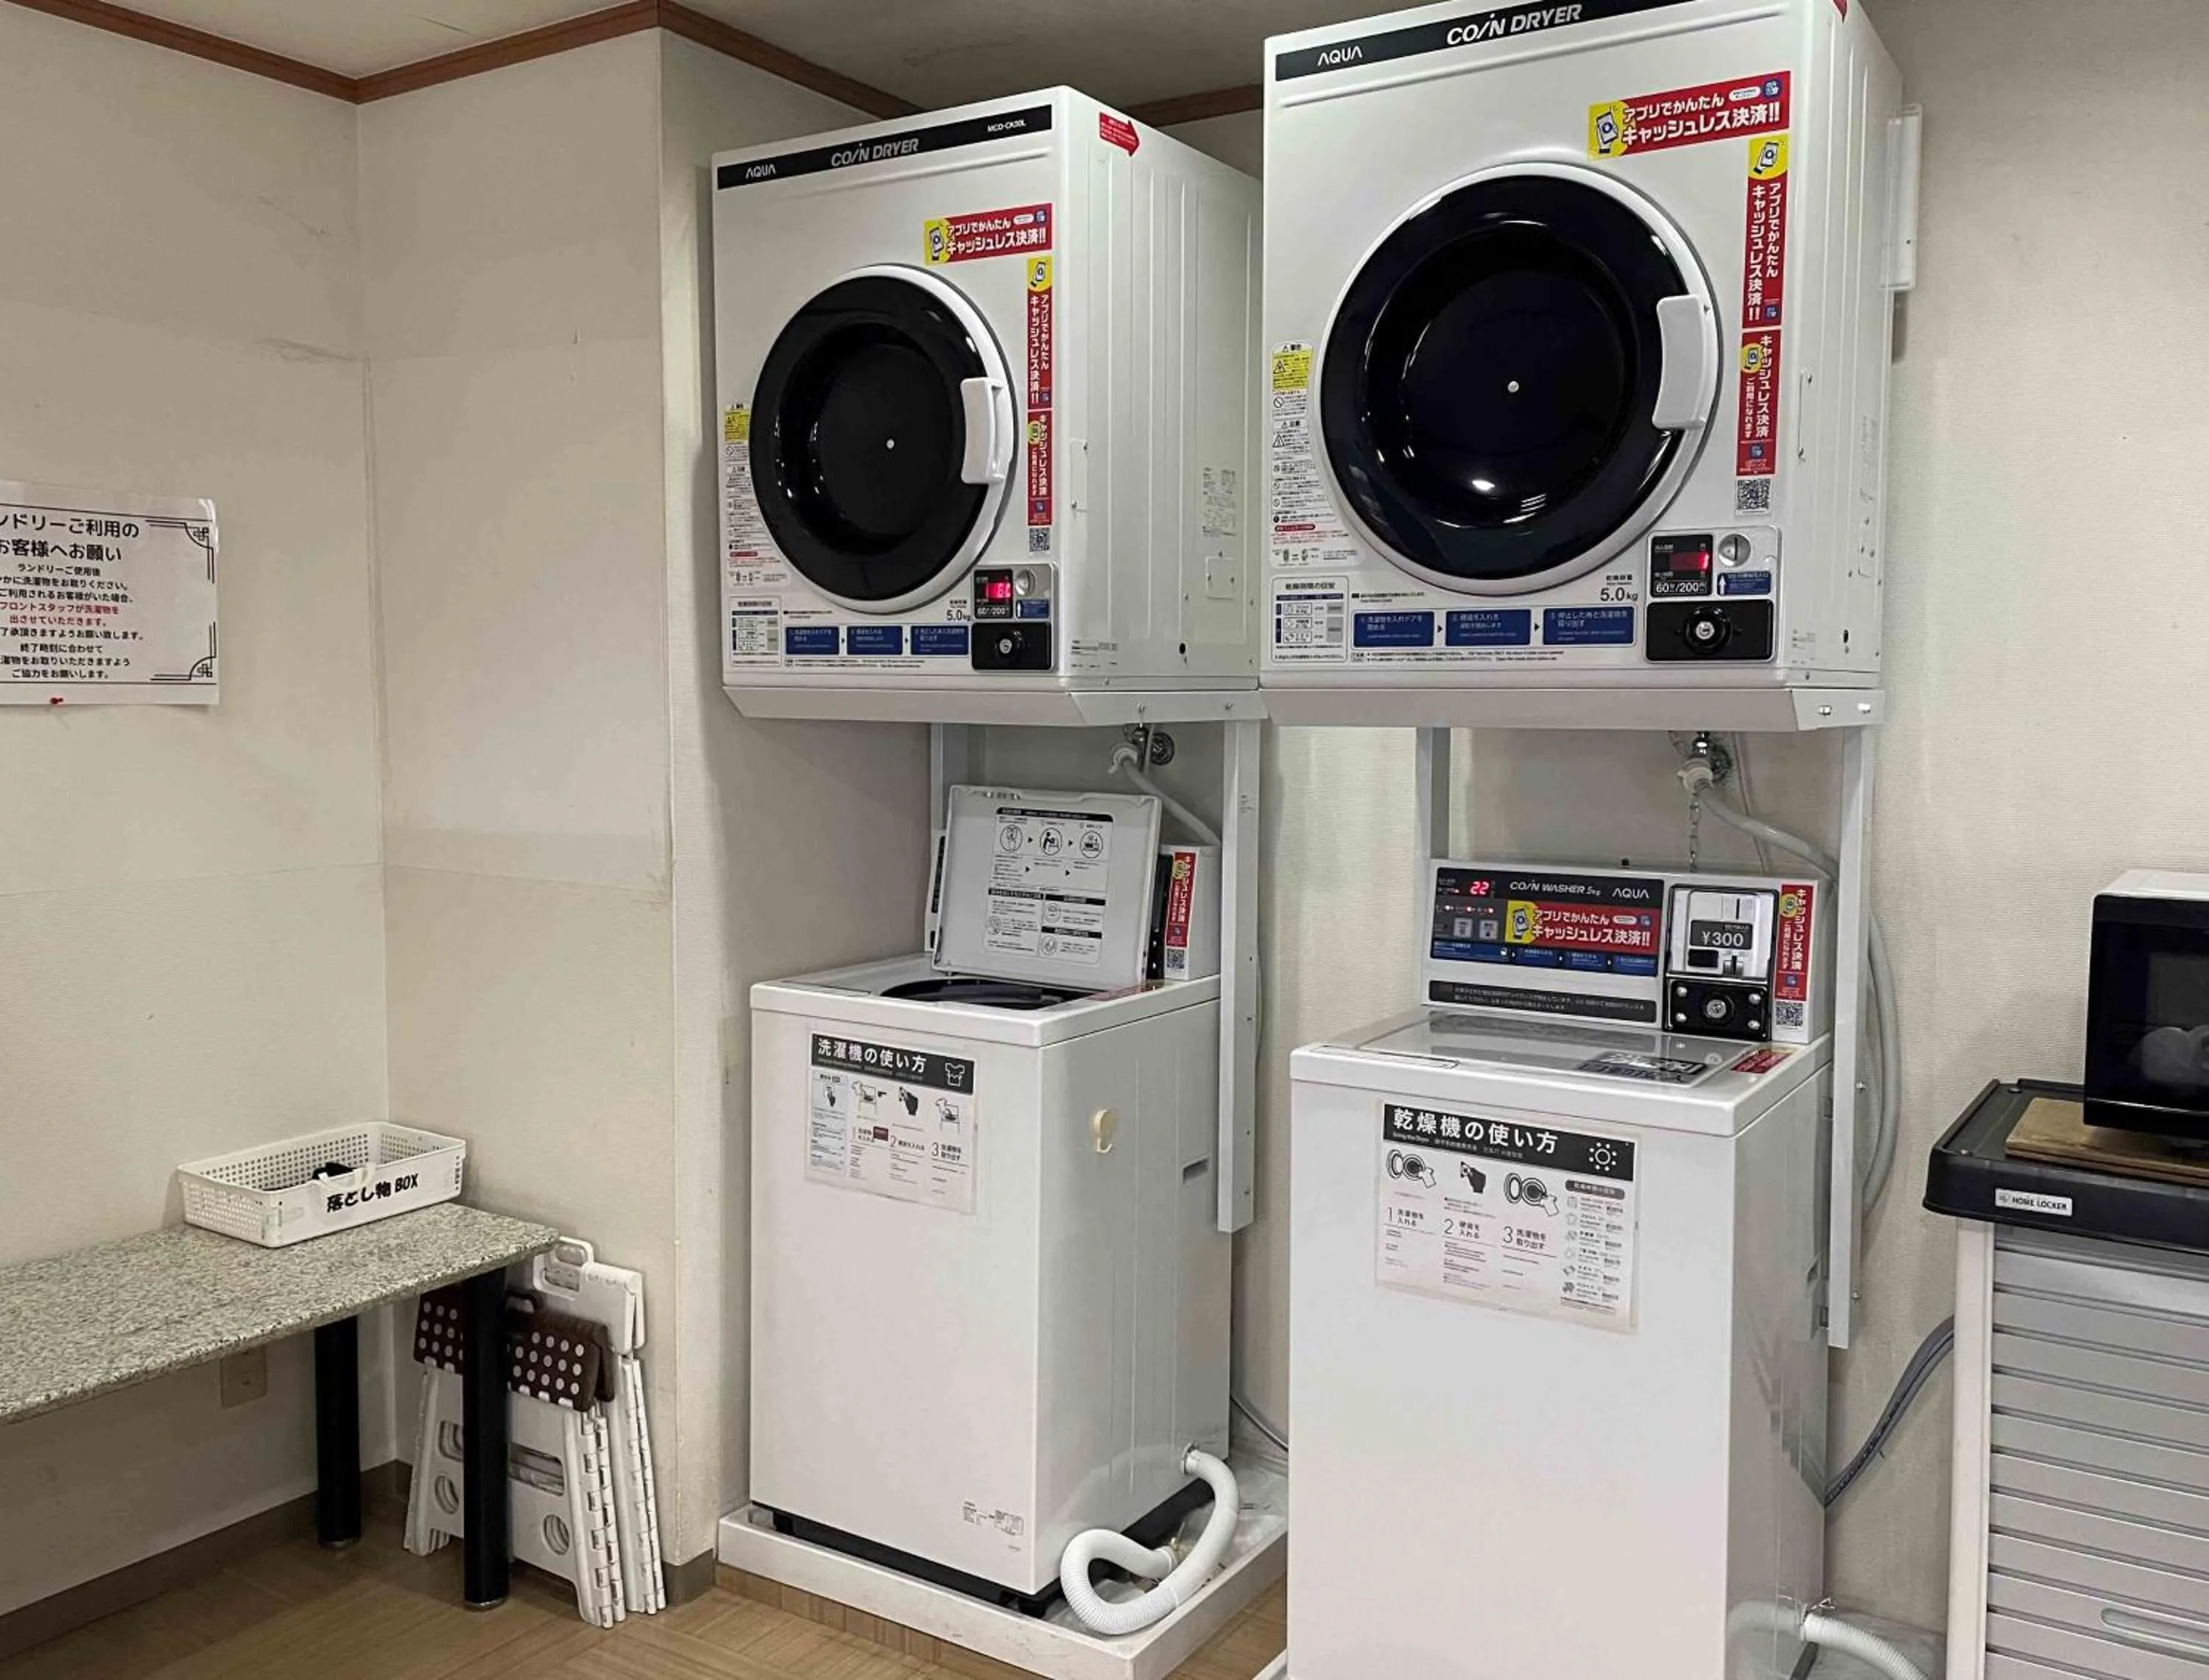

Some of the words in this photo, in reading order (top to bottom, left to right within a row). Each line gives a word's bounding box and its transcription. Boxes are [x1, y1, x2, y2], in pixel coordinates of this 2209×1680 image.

[1510, 3, 1582, 33] DRYER
[1317, 46, 1363, 66] AQUA
[1623, 93, 1724, 123] アプリでかんたん
[1621, 102, 1780, 145] キャッシュレス決済!!
[872, 138, 919, 159] DRYER
[745, 163, 776, 180] AQUA
[947, 218, 1011, 236] アプリでかんたん
[1766, 182, 1781, 278] アプリでかんたん
[947, 227, 1046, 255] キャッシュレス決済!!
[0, 538, 121, 562] お客様へお願い
[0, 576, 128, 590] かに洗濯物をお取りください。
[1470, 880, 1489, 894] 22
[1541, 883, 1585, 894] WASHER
[1611, 888, 1649, 899] AQUA
[1532, 909, 1610, 925] アプリでかんたん
[1702, 931, 1744, 947] ¥300
[818, 1038, 927, 1073] 洗濯機の使い方
[1392, 1108, 1559, 1154] 乾燥機の使い方
[931, 1142, 940, 1157] 3
[327, 1180, 392, 1213] 落とし物
[395, 1173, 419, 1193] BOX
[2012, 1196, 2034, 1207] HOME
[2037, 1199, 2068, 1211] LOCKER
[1444, 1218, 1454, 1235] 2
[1503, 1226, 1513, 1243] 3
